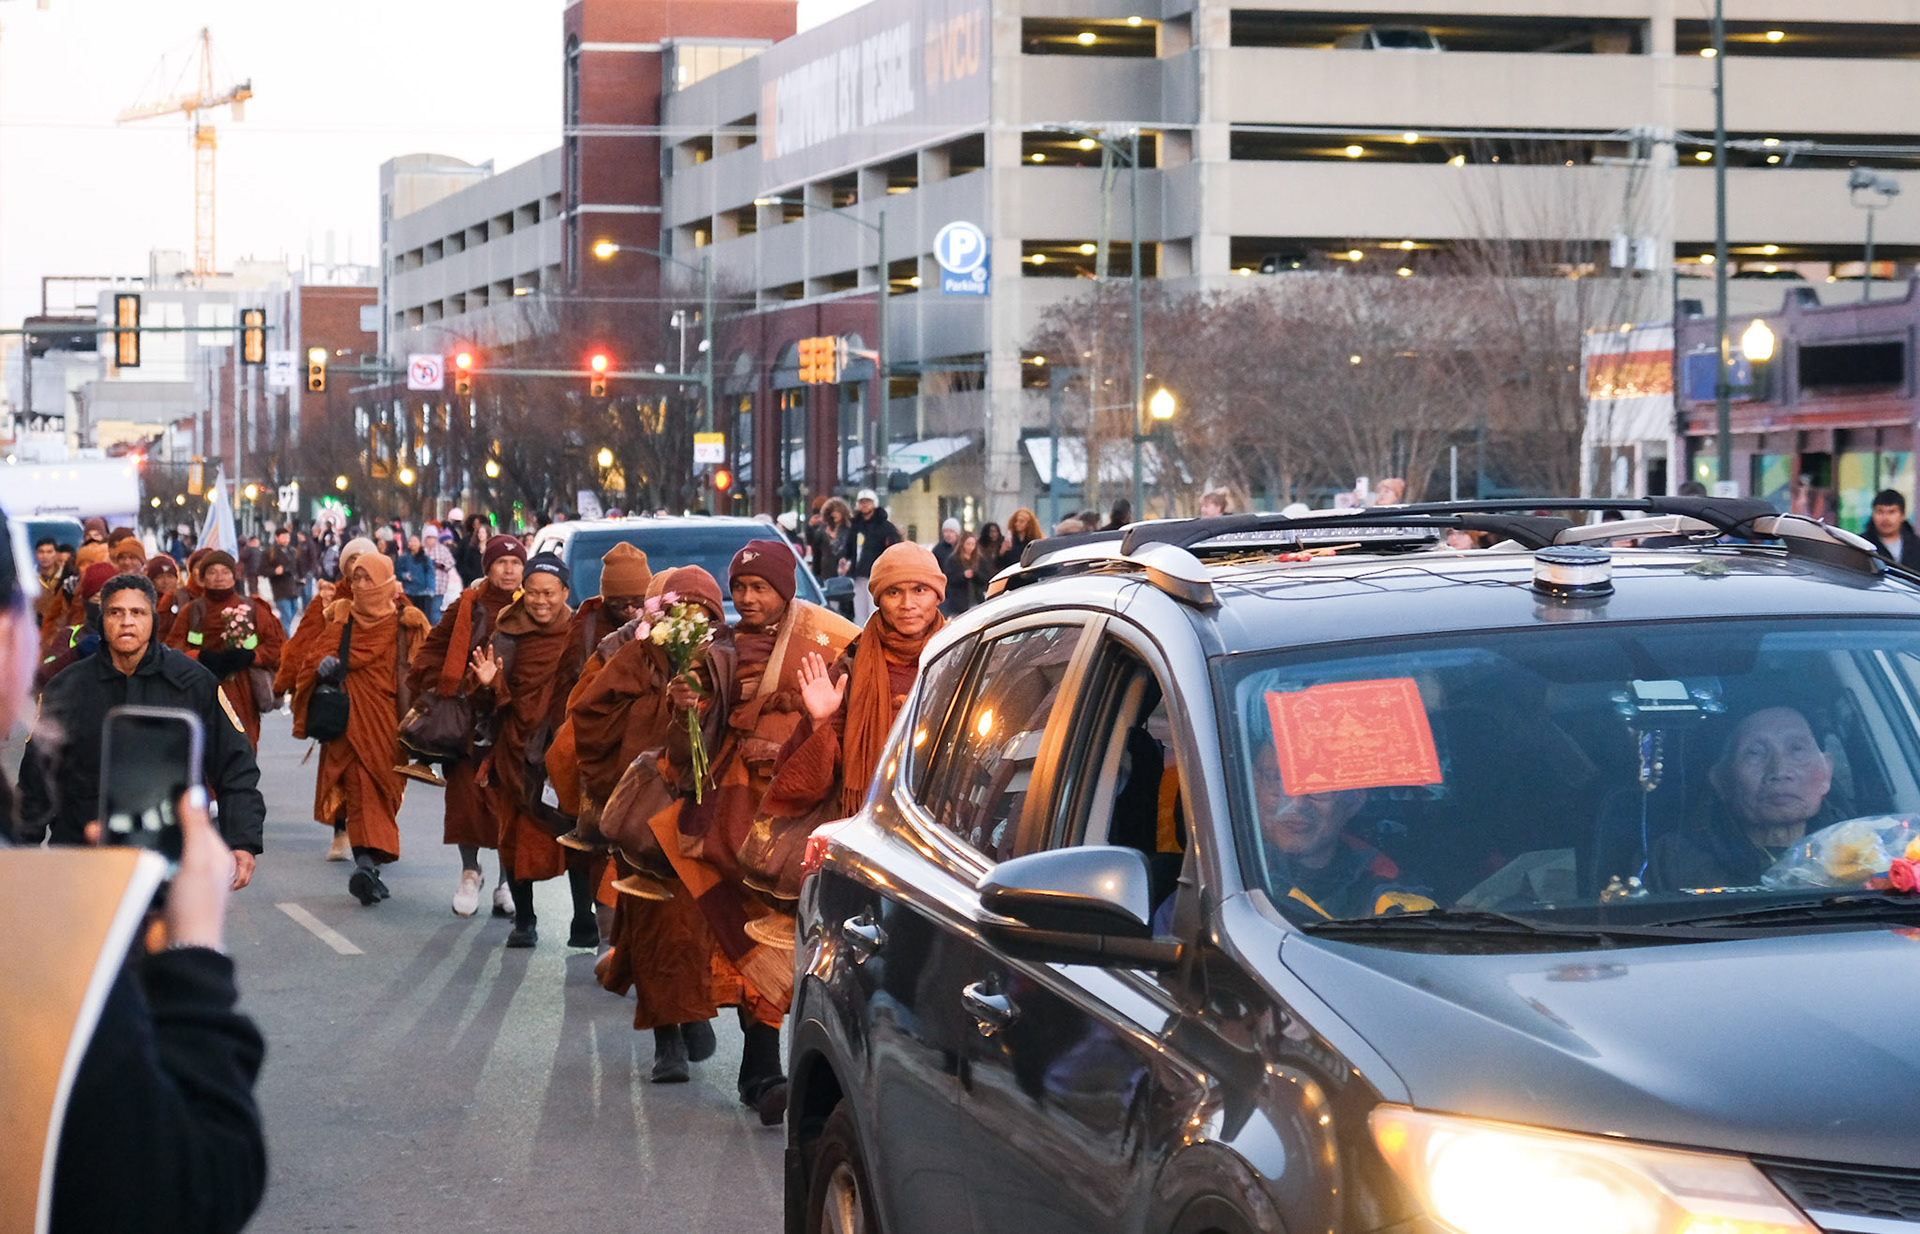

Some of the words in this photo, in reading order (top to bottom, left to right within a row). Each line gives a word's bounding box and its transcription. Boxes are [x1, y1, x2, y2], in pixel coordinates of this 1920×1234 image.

[940, 7, 981, 83] VCU
[949, 228, 977, 266] P
[945, 279, 985, 294] Parking
